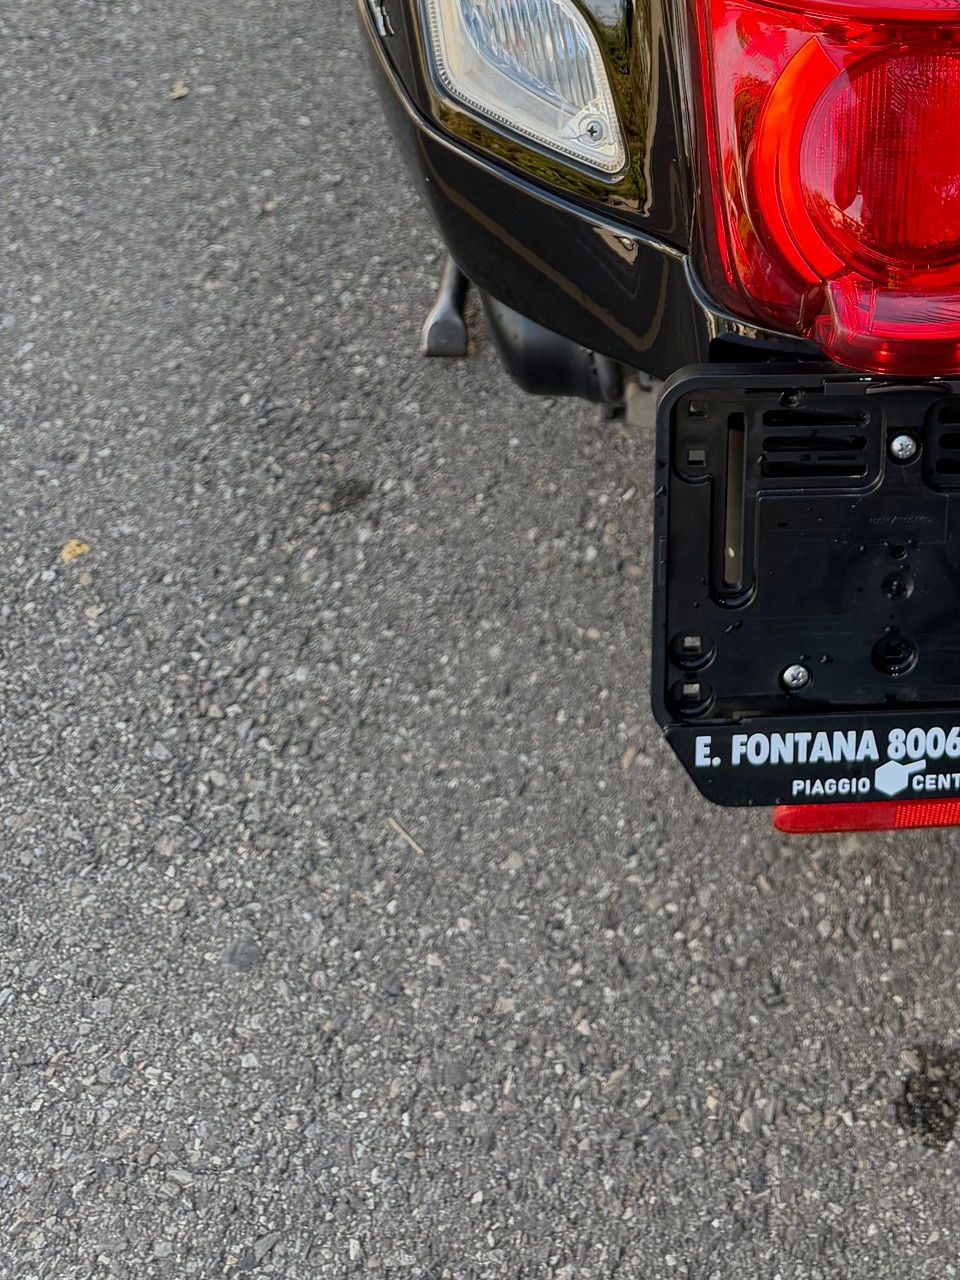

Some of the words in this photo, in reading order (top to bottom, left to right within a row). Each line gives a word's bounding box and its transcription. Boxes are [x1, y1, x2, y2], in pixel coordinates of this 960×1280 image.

[694, 734, 722, 767] E.
[731, 729, 879, 765] FONTANA
[791, 776, 871, 797] PIAGGIO
